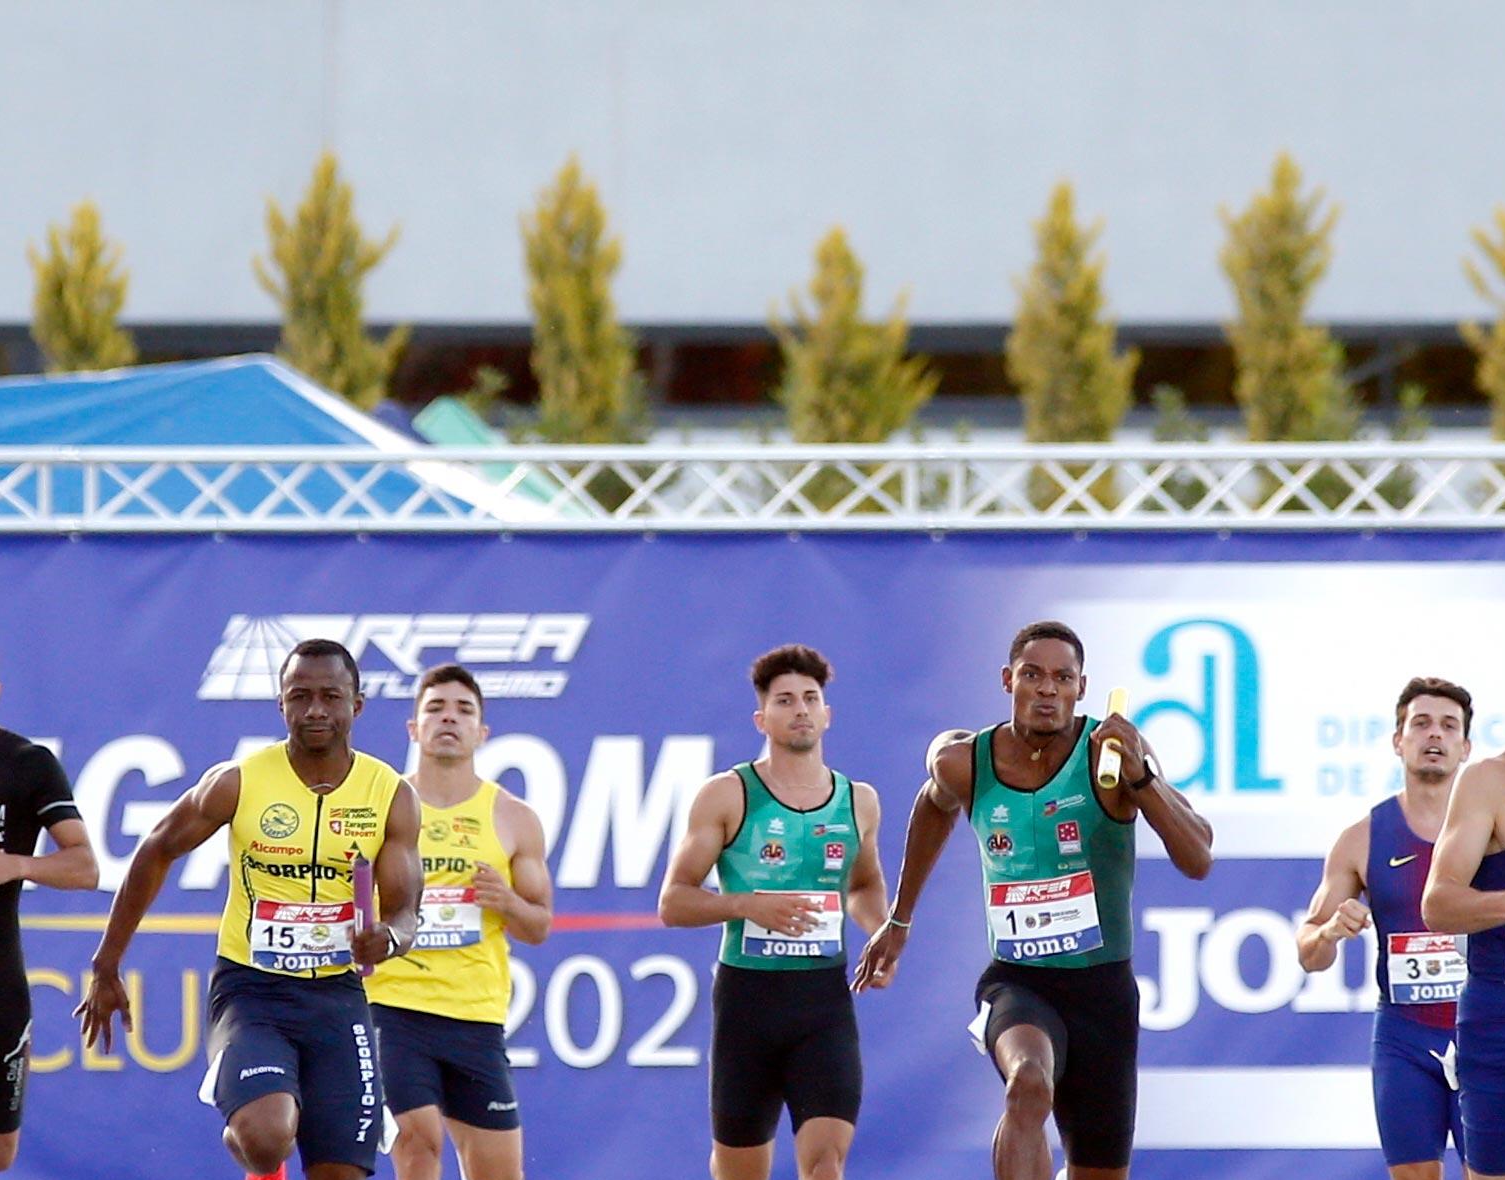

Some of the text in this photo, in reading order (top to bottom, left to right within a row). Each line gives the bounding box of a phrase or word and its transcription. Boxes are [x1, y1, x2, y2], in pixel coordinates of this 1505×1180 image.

[250, 840, 304, 856] Alcampo
[1006, 909, 1018, 935] 1
[263, 925, 294, 949] 15
[416, 932, 463, 948] oma
[762, 940, 822, 956] Joma
[1013, 938, 1078, 960] Joma
[1405, 958, 1421, 980] 3
[506, 954, 703, 1071] 202
